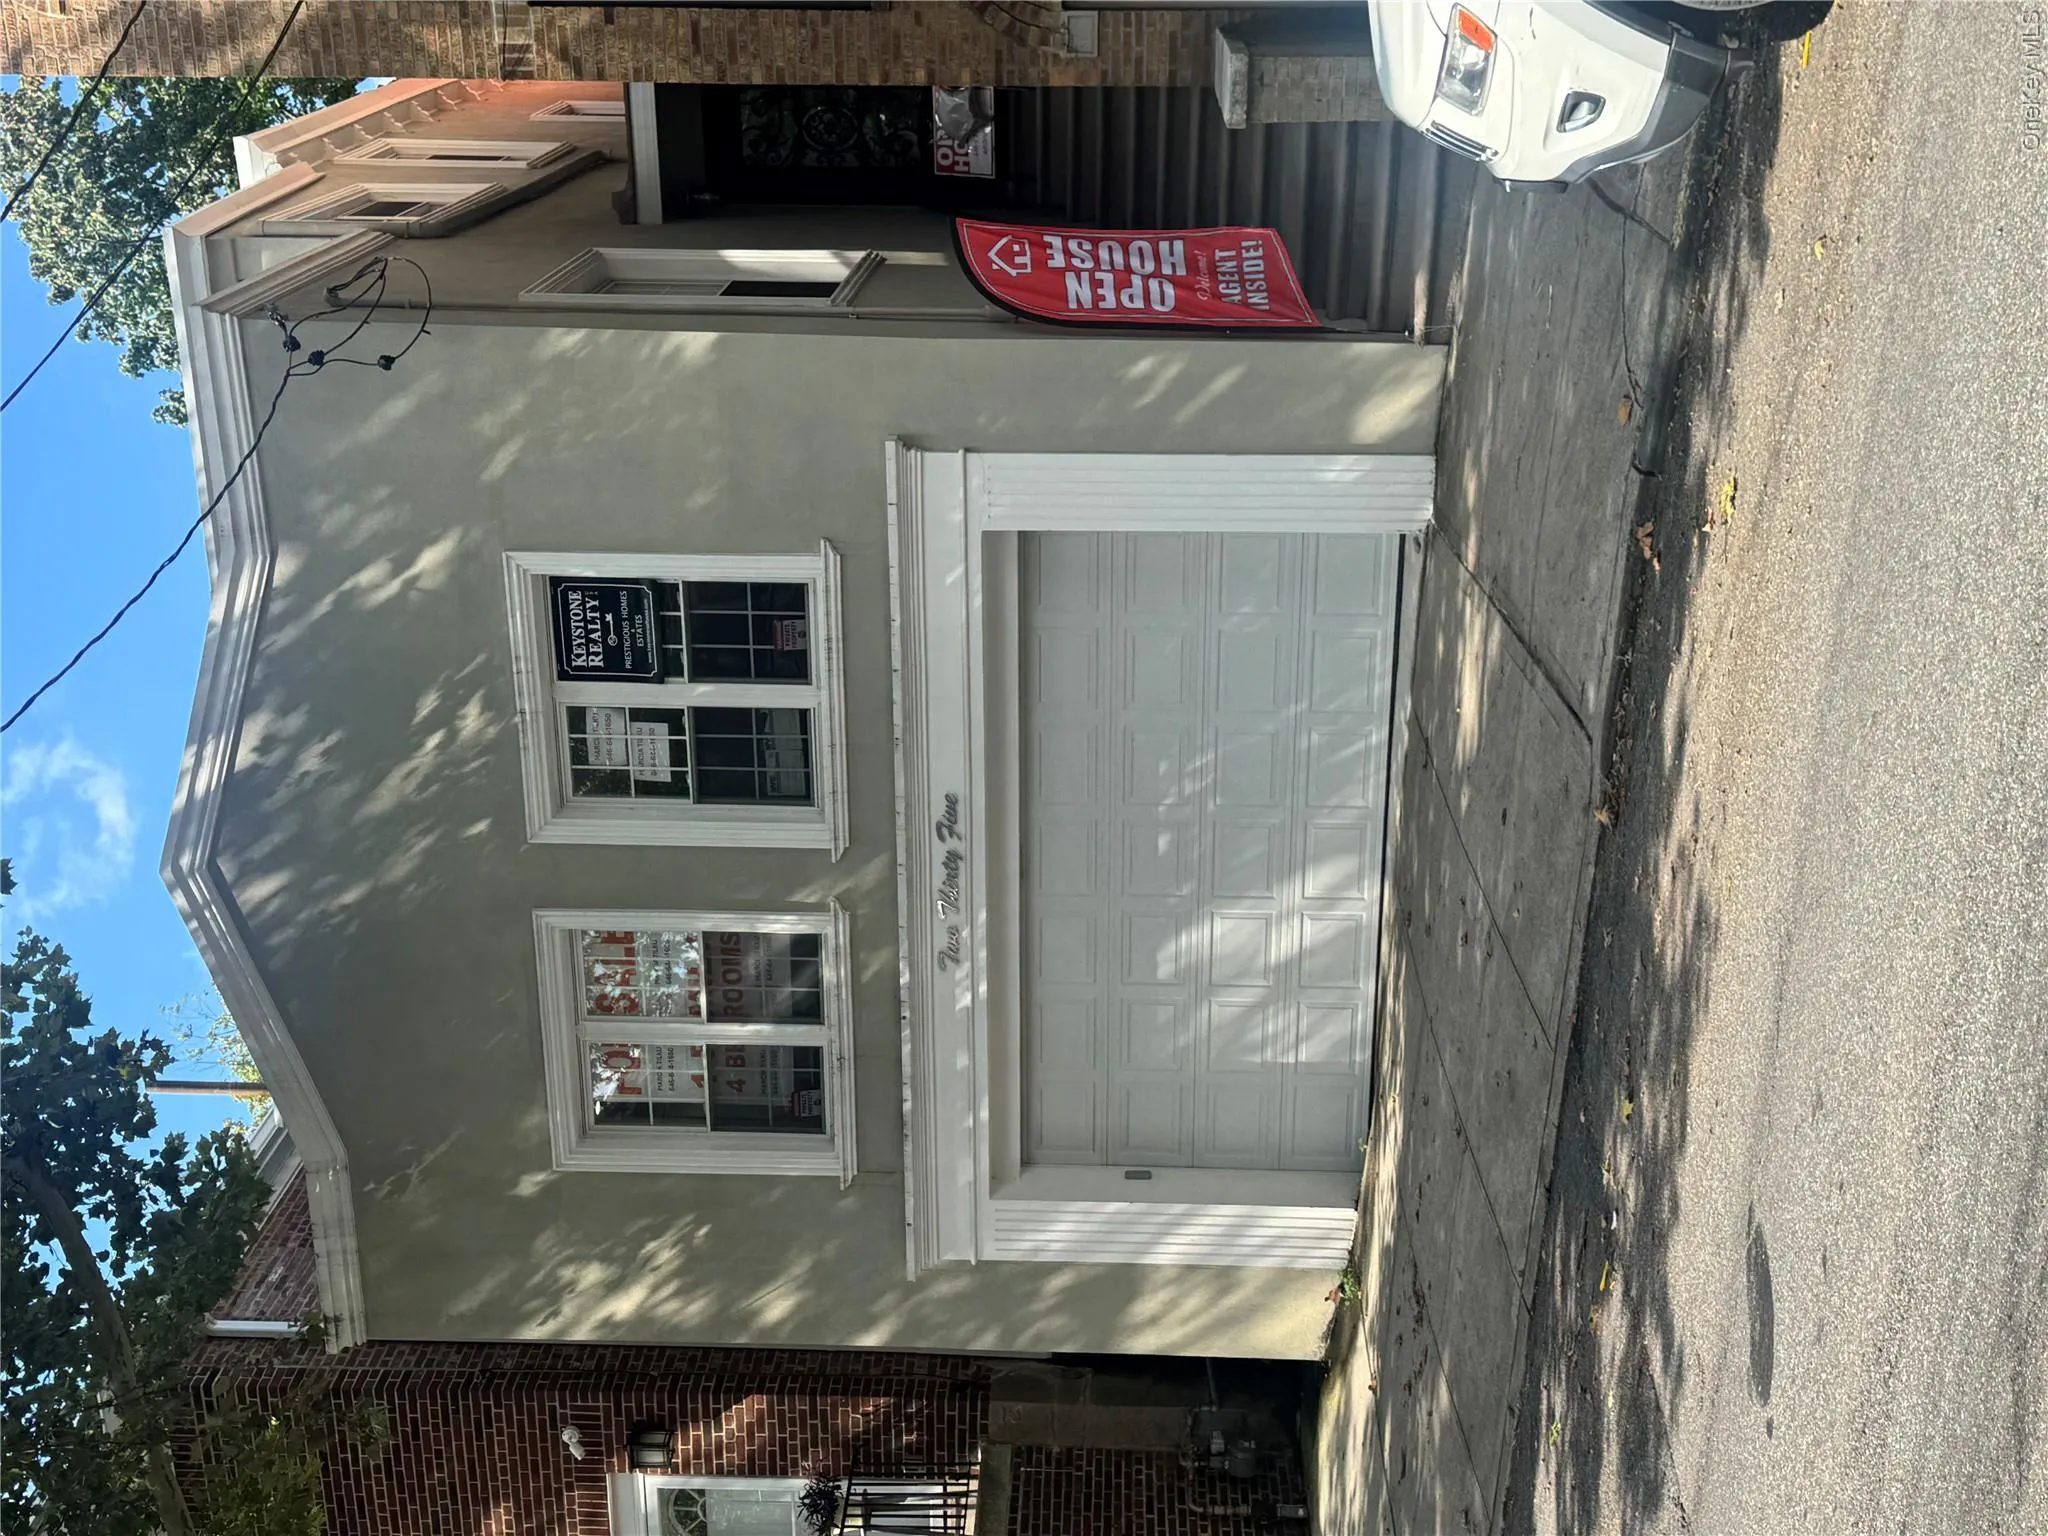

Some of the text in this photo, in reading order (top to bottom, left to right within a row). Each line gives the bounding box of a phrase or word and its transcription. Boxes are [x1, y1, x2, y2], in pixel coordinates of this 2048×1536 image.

[936, 129, 954, 166] OP
[1042, 236, 1187, 276] HOUSE
[1214, 248, 1242, 305] AGENT
[1241, 239, 1270, 310] INSIDE!
[1064, 271, 1176, 311] OPEN
[568, 590, 588, 668] KEYSTONE
[585, 598, 604, 668] REALTY
[620, 590, 632, 669] PRESTIGIOUS HOMES
[634, 614, 644, 646] ESTATES
[936, 792, 964, 972] Two Thirty Five
[598, 1044, 642, 1095] FO
[726, 1079, 746, 1093] 4
